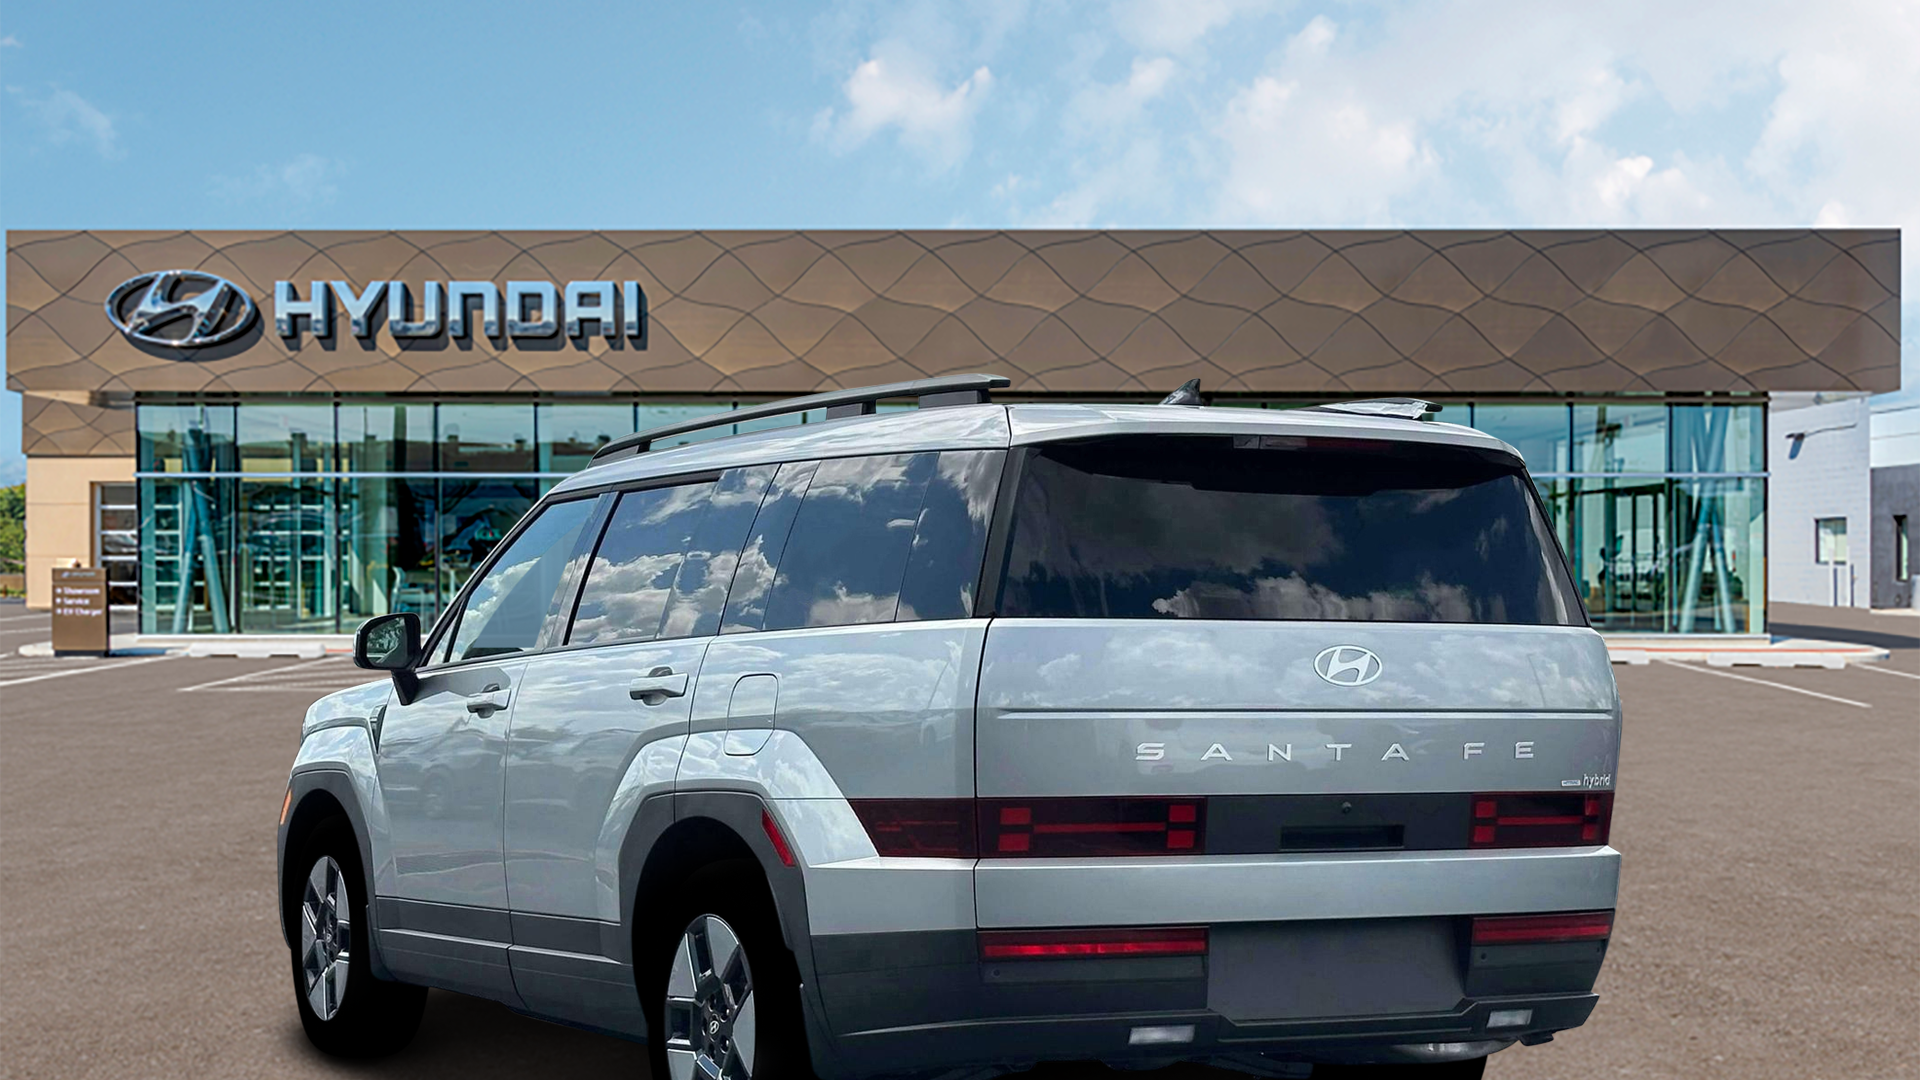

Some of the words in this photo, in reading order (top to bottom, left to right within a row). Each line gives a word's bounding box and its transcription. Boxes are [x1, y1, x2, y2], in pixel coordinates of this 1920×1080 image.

[274, 280, 642, 337] HYUNDAI
[63, 587, 100, 595] Showroom
[63, 597, 90, 605] Service
[75, 608, 102, 617] Charger
[1135, 742, 1410, 762] SANTA
[1463, 741, 1535, 760] FE
[1583, 773, 1611, 789] hybrid
